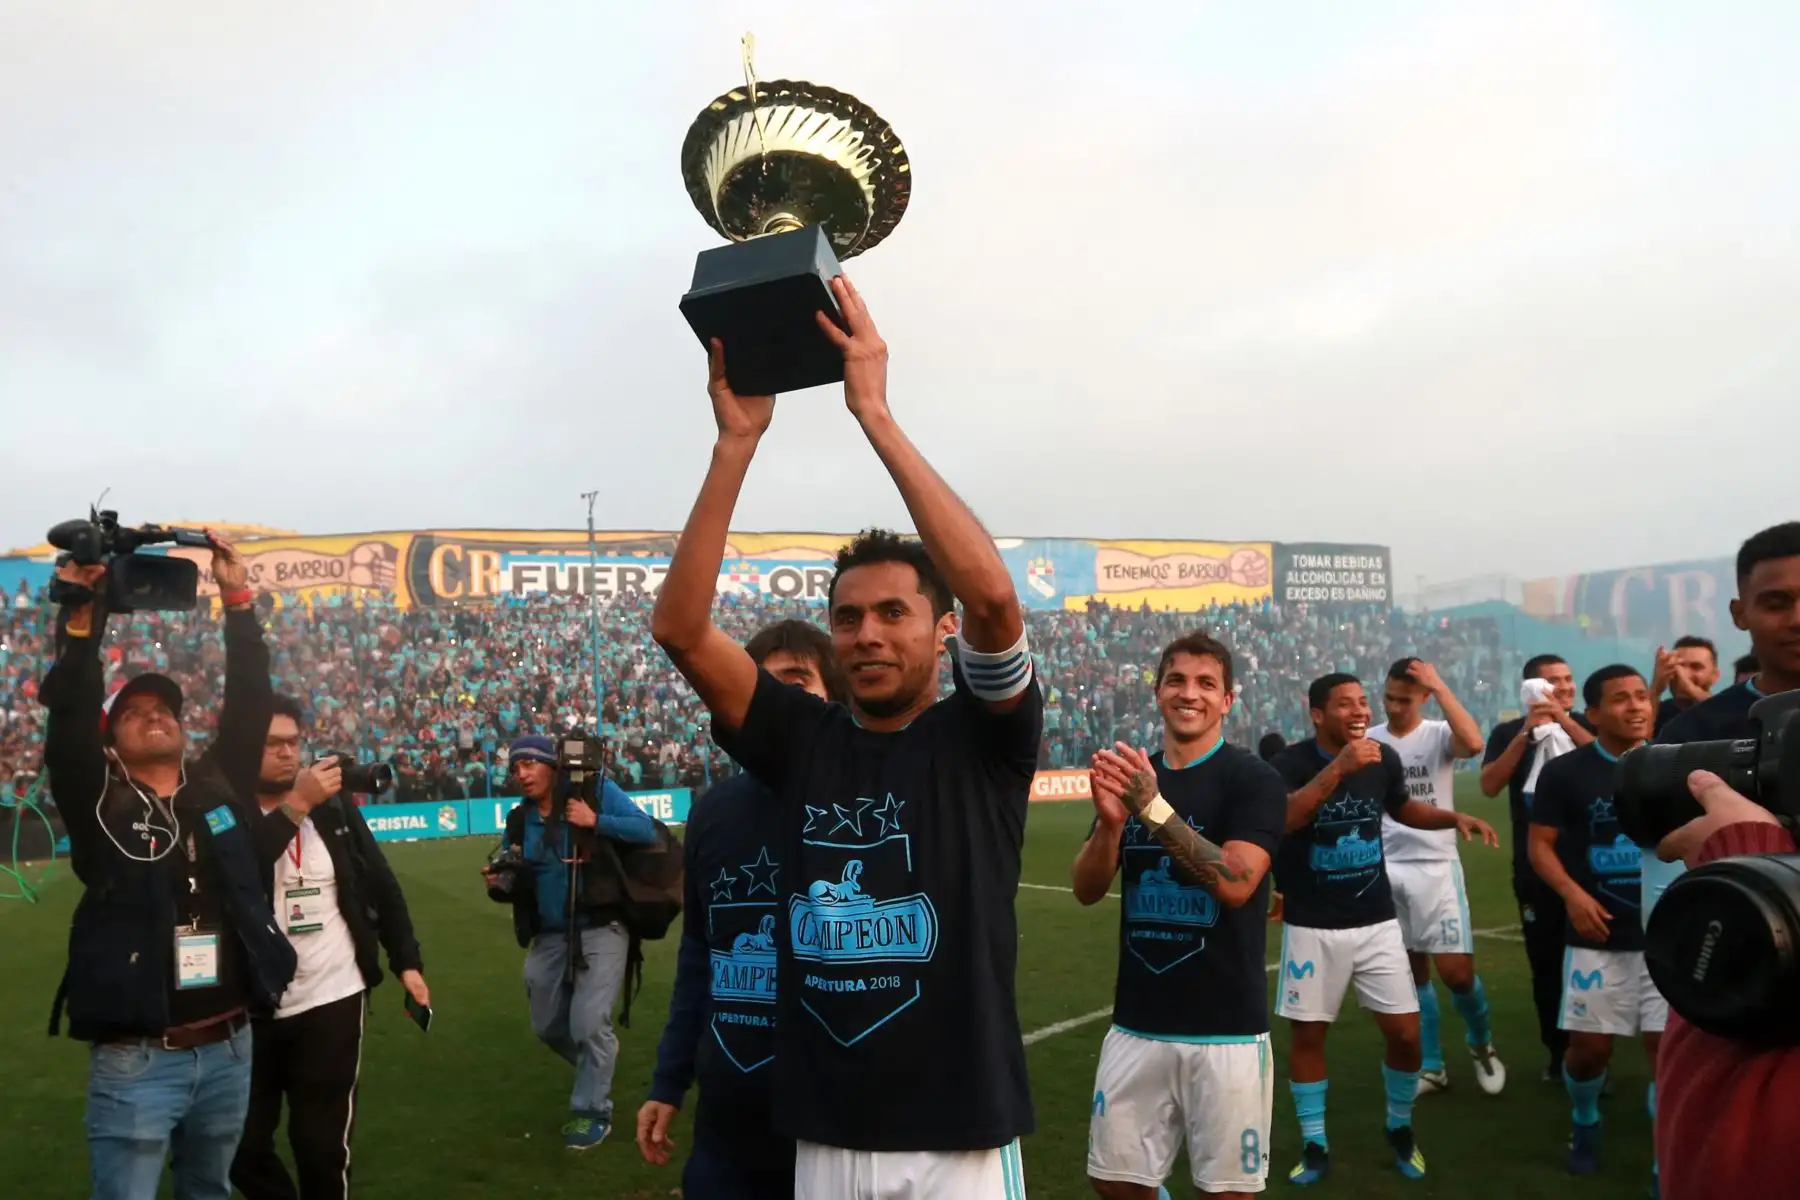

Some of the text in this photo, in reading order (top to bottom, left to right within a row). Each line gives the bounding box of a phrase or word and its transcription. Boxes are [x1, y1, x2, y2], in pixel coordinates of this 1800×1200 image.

[275, 559, 345, 582] BARRIO
[1292, 554, 1382, 569] TOMAR BEBIDAS
[1103, 562, 1228, 580] TENEMOS BARRIO
[1287, 571, 1385, 585] ALCOHOLICAS EN
[1286, 586, 1329, 601] EXCESO
[1331, 587, 1344, 600] ES
[367, 815, 429, 832] CRISTAL
[797, 911, 917, 952] CAMPEÓN
[1439, 918, 1461, 945] 15
[1693, 920, 1723, 982] Canon
[805, 974, 901, 992] APERTURA 2018
[1240, 1128, 1262, 1175] 8
